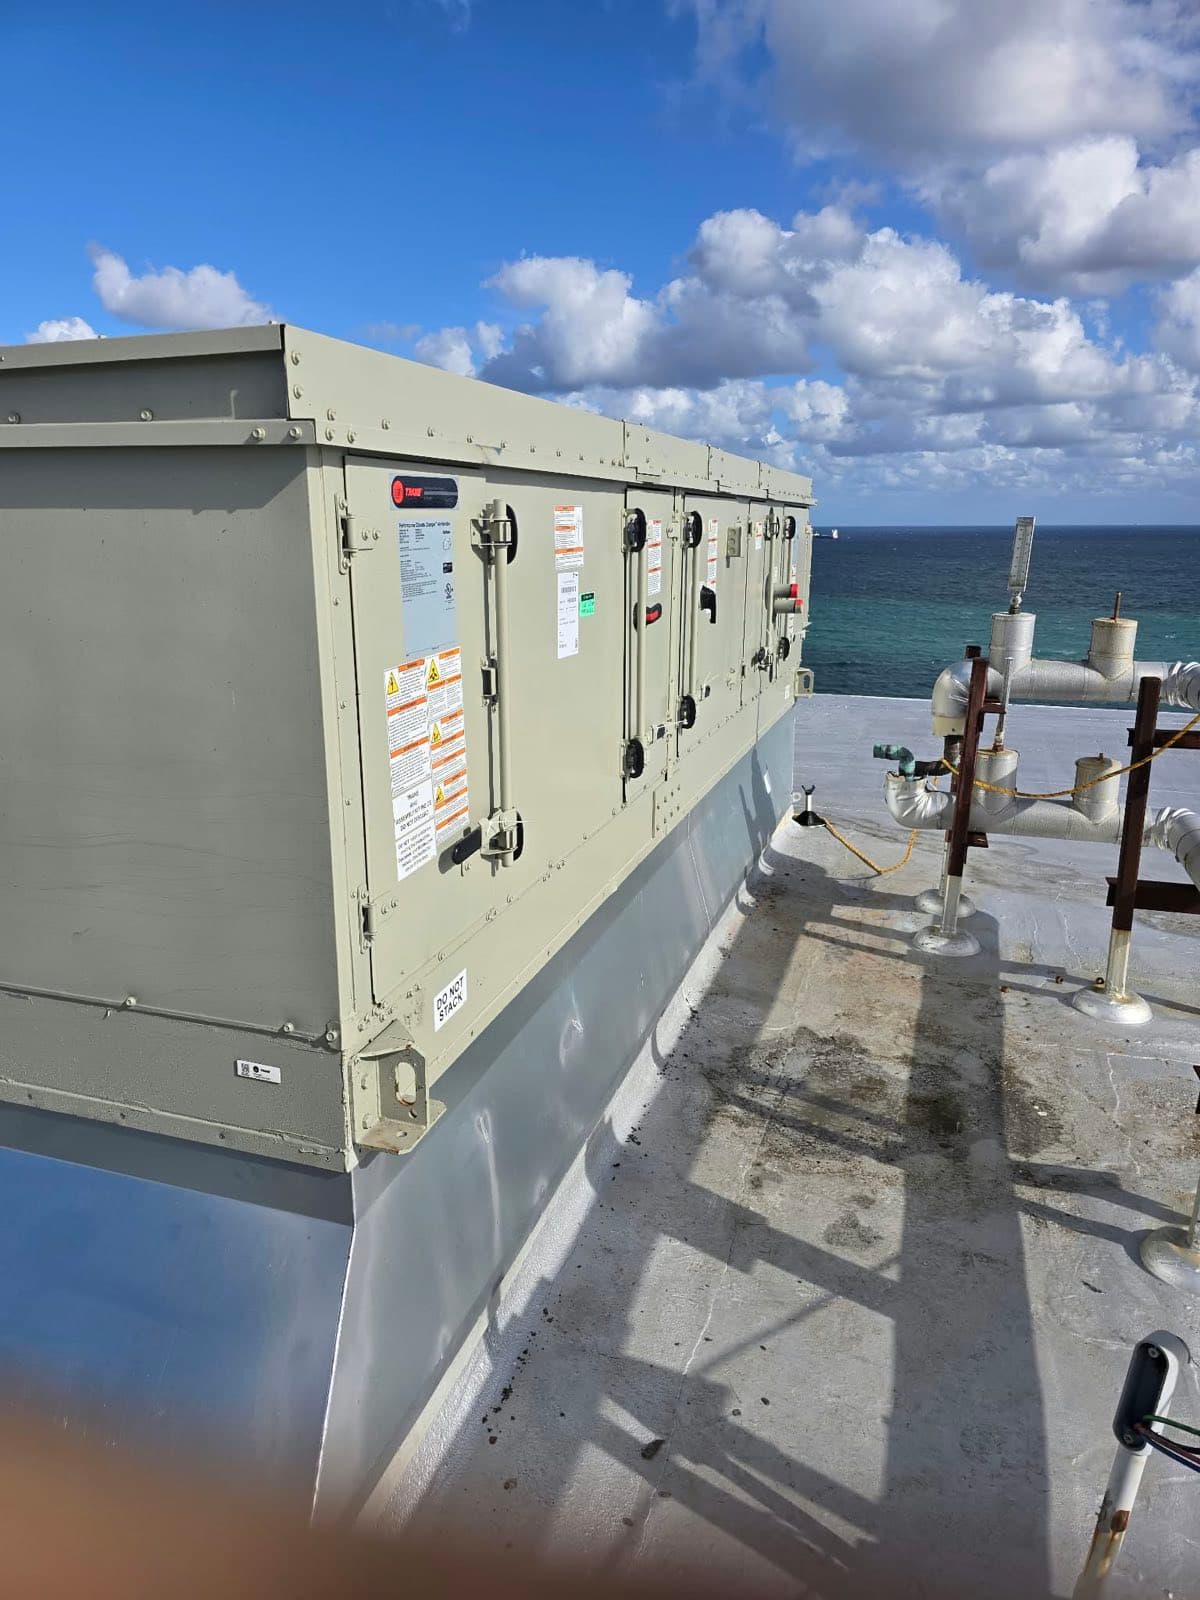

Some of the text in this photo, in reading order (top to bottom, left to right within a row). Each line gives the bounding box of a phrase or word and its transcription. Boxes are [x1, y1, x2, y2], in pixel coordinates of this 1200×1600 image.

[437, 976, 463, 1010] DO NOT
[440, 991, 463, 1021] STACK
